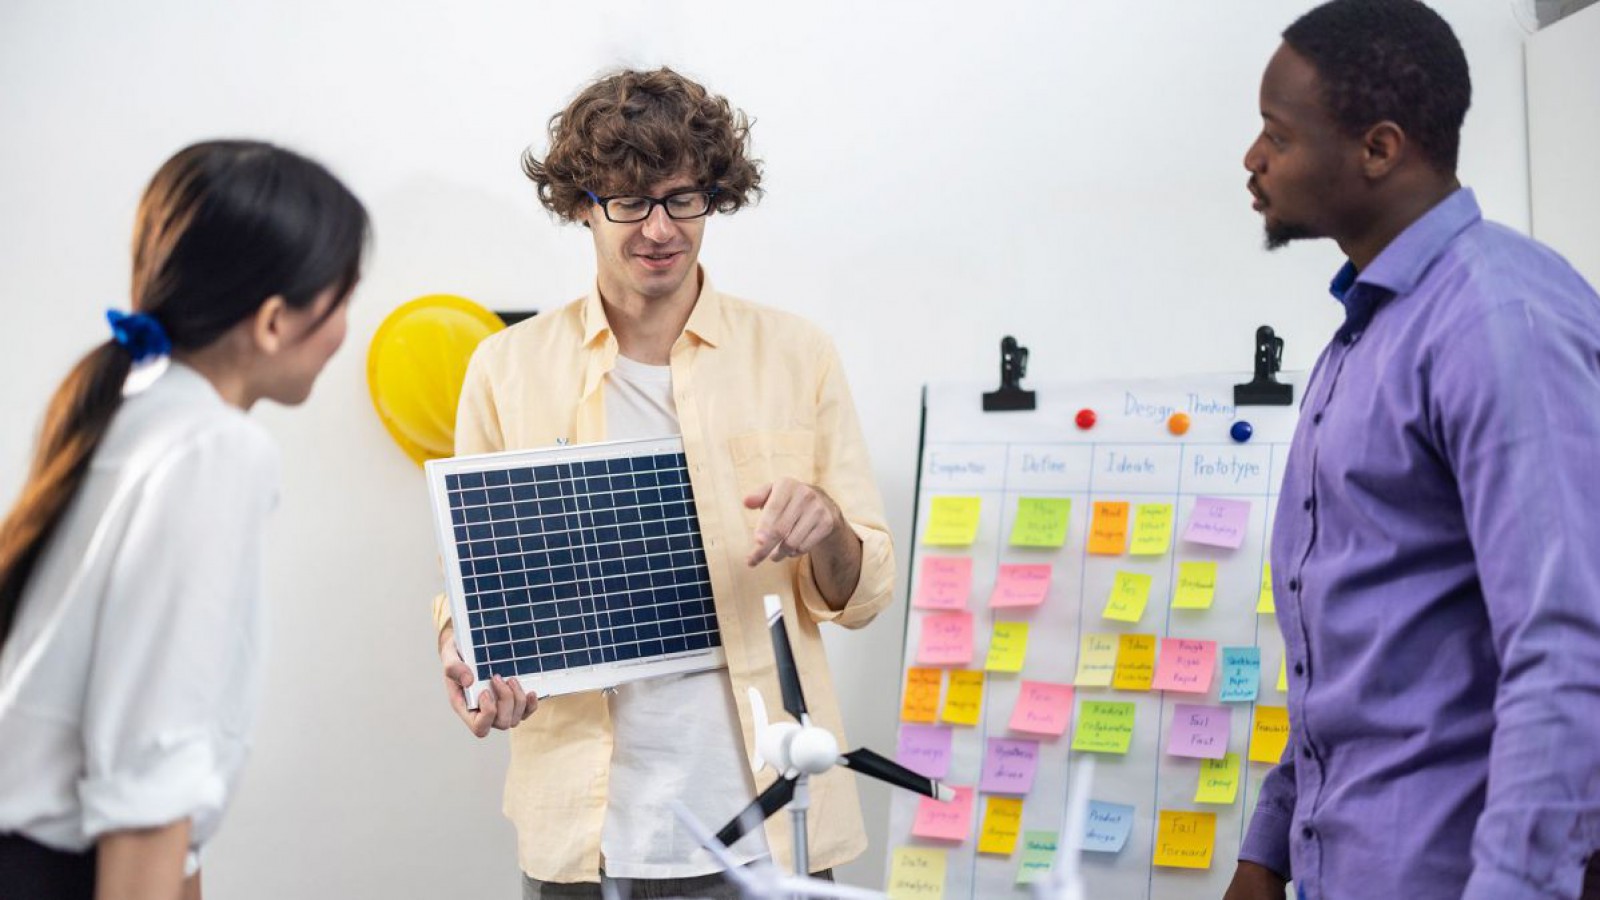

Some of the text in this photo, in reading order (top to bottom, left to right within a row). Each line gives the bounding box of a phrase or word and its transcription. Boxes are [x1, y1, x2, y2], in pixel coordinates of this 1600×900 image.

[1124, 391, 1237, 423] Design Thinking
[1022, 454, 1066, 473] Define
[1106, 452, 1155, 473] Ideate
[1194, 454, 1260, 483] Prototype
